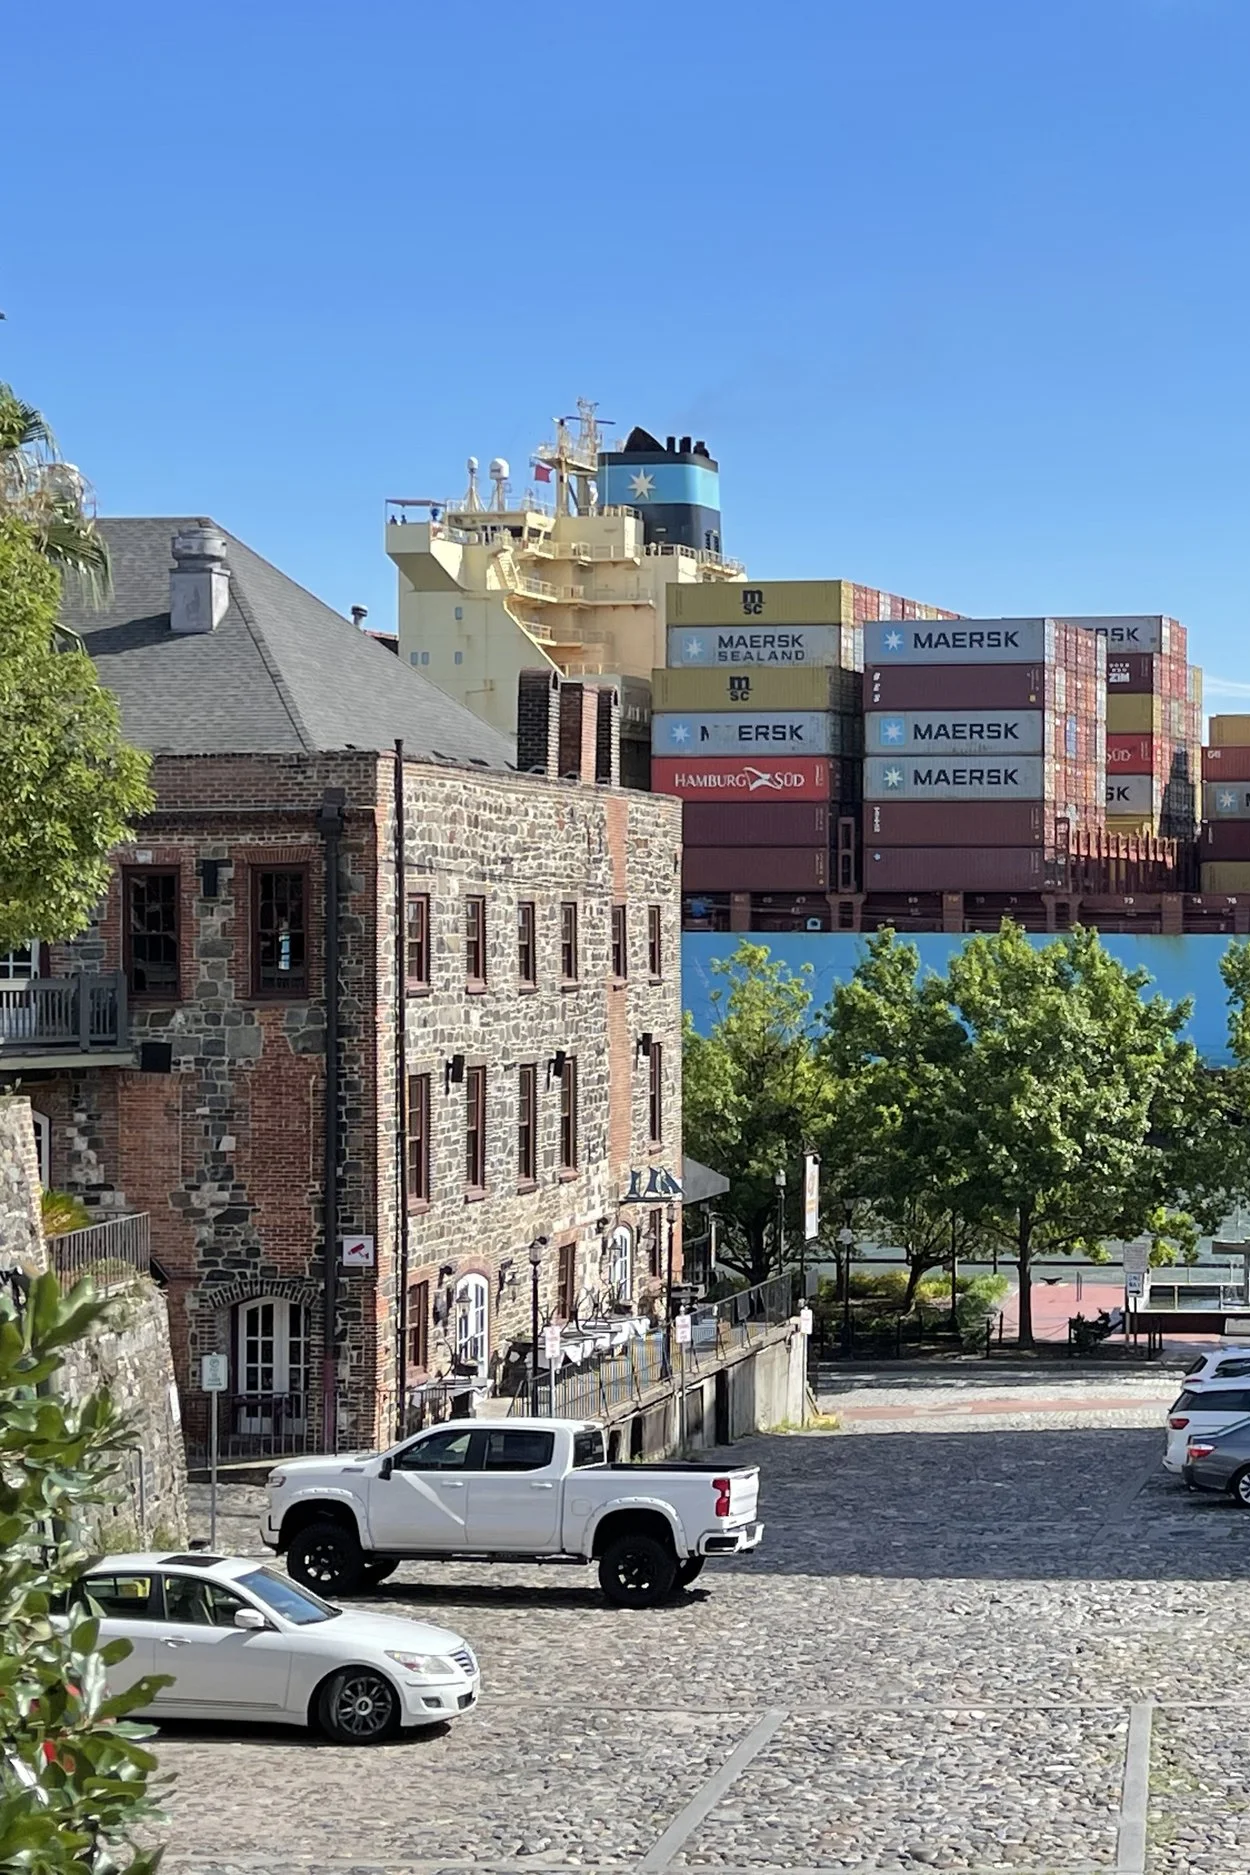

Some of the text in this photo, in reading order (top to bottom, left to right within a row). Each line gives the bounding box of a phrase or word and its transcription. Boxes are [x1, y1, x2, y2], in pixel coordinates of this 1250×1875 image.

[718, 634, 804, 649] MAERSK
[913, 630, 1019, 649] MAERSK
[718, 650, 805, 662] SEALAND
[700, 725, 804, 741] MERSK
[913, 722, 1019, 741] MAERSK
[675, 773, 747, 787] HAMBURG
[774, 772, 805, 787] SÜD
[913, 768, 1019, 786] MAERSK
